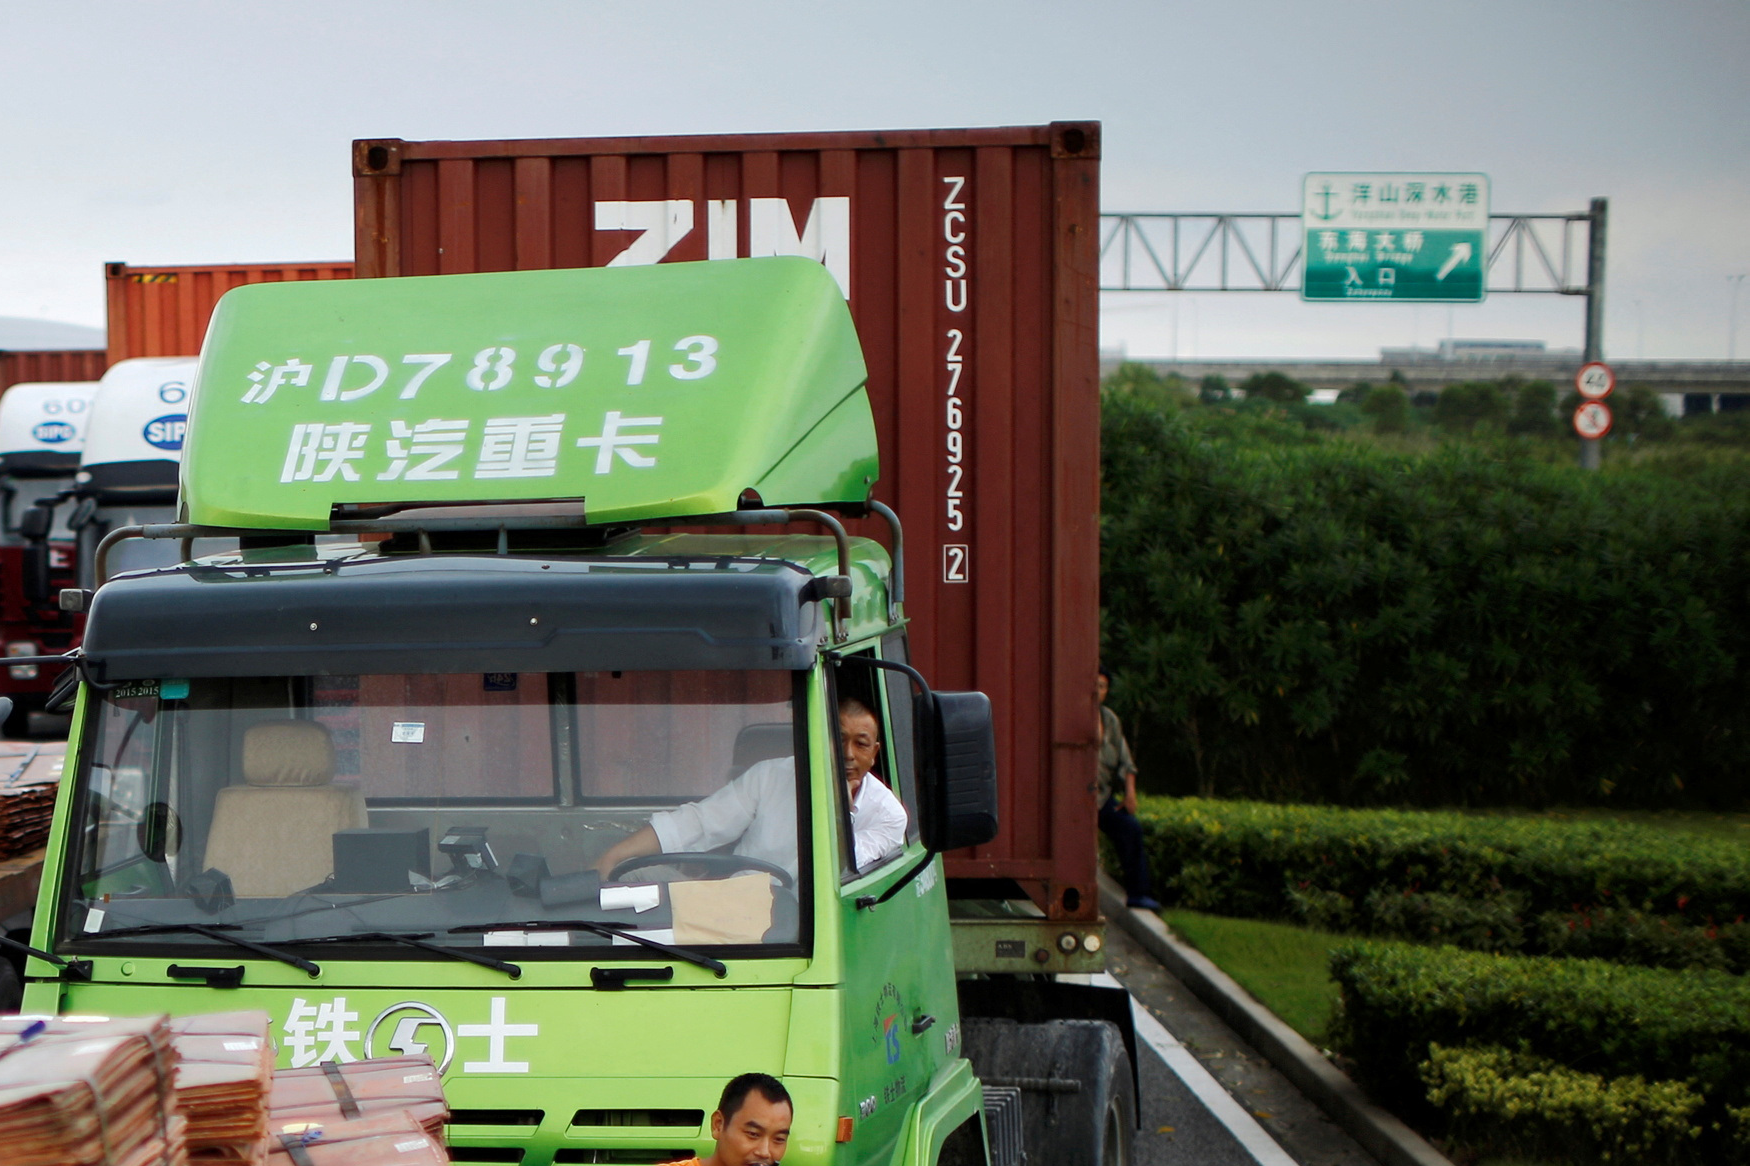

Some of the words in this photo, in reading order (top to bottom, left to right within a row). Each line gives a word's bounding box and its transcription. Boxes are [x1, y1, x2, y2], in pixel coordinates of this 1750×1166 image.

[1352, 181, 1479, 204] 洋山深水港
[594, 196, 850, 300] ZIM
[943, 175, 967, 312] ZCSU
[1345, 267, 1396, 285] 入口
[240, 335, 719, 404] 沪D78913
[43, 399, 92, 415] 60
[946, 328, 963, 532] 276925
[279, 411, 663, 483] 陕汽重卡
[115, 687, 137, 698] 2015
[138, 686, 159, 696] 2015
[283, 997, 360, 1069] 铁
[457, 997, 538, 1073] 士
